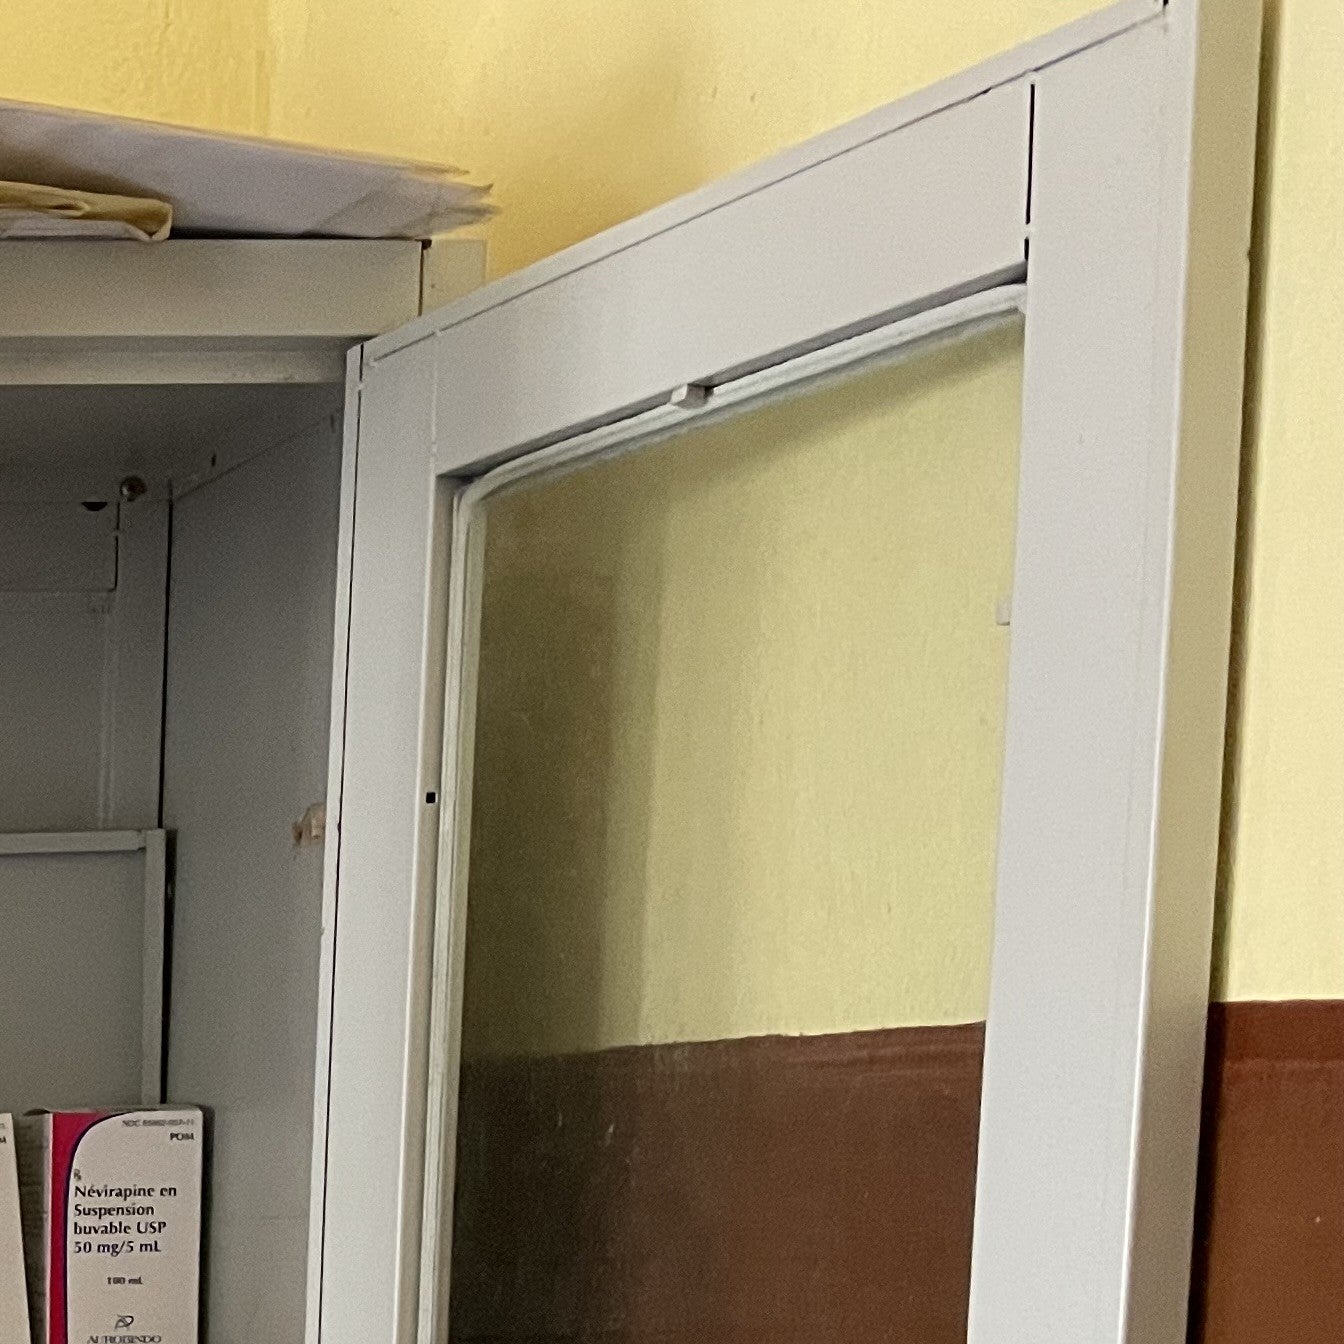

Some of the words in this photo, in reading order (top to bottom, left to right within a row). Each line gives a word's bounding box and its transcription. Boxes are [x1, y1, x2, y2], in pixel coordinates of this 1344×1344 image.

[74, 1184, 156, 1201] Névirapine
[160, 1186, 177, 1197] en
[74, 1203, 155, 1219] Suspension
[73, 1221, 132, 1235] buvable
[136, 1221, 167, 1234] USP
[74, 1241, 92, 1253] 50
[97, 1240, 134, 1257] mg/5
